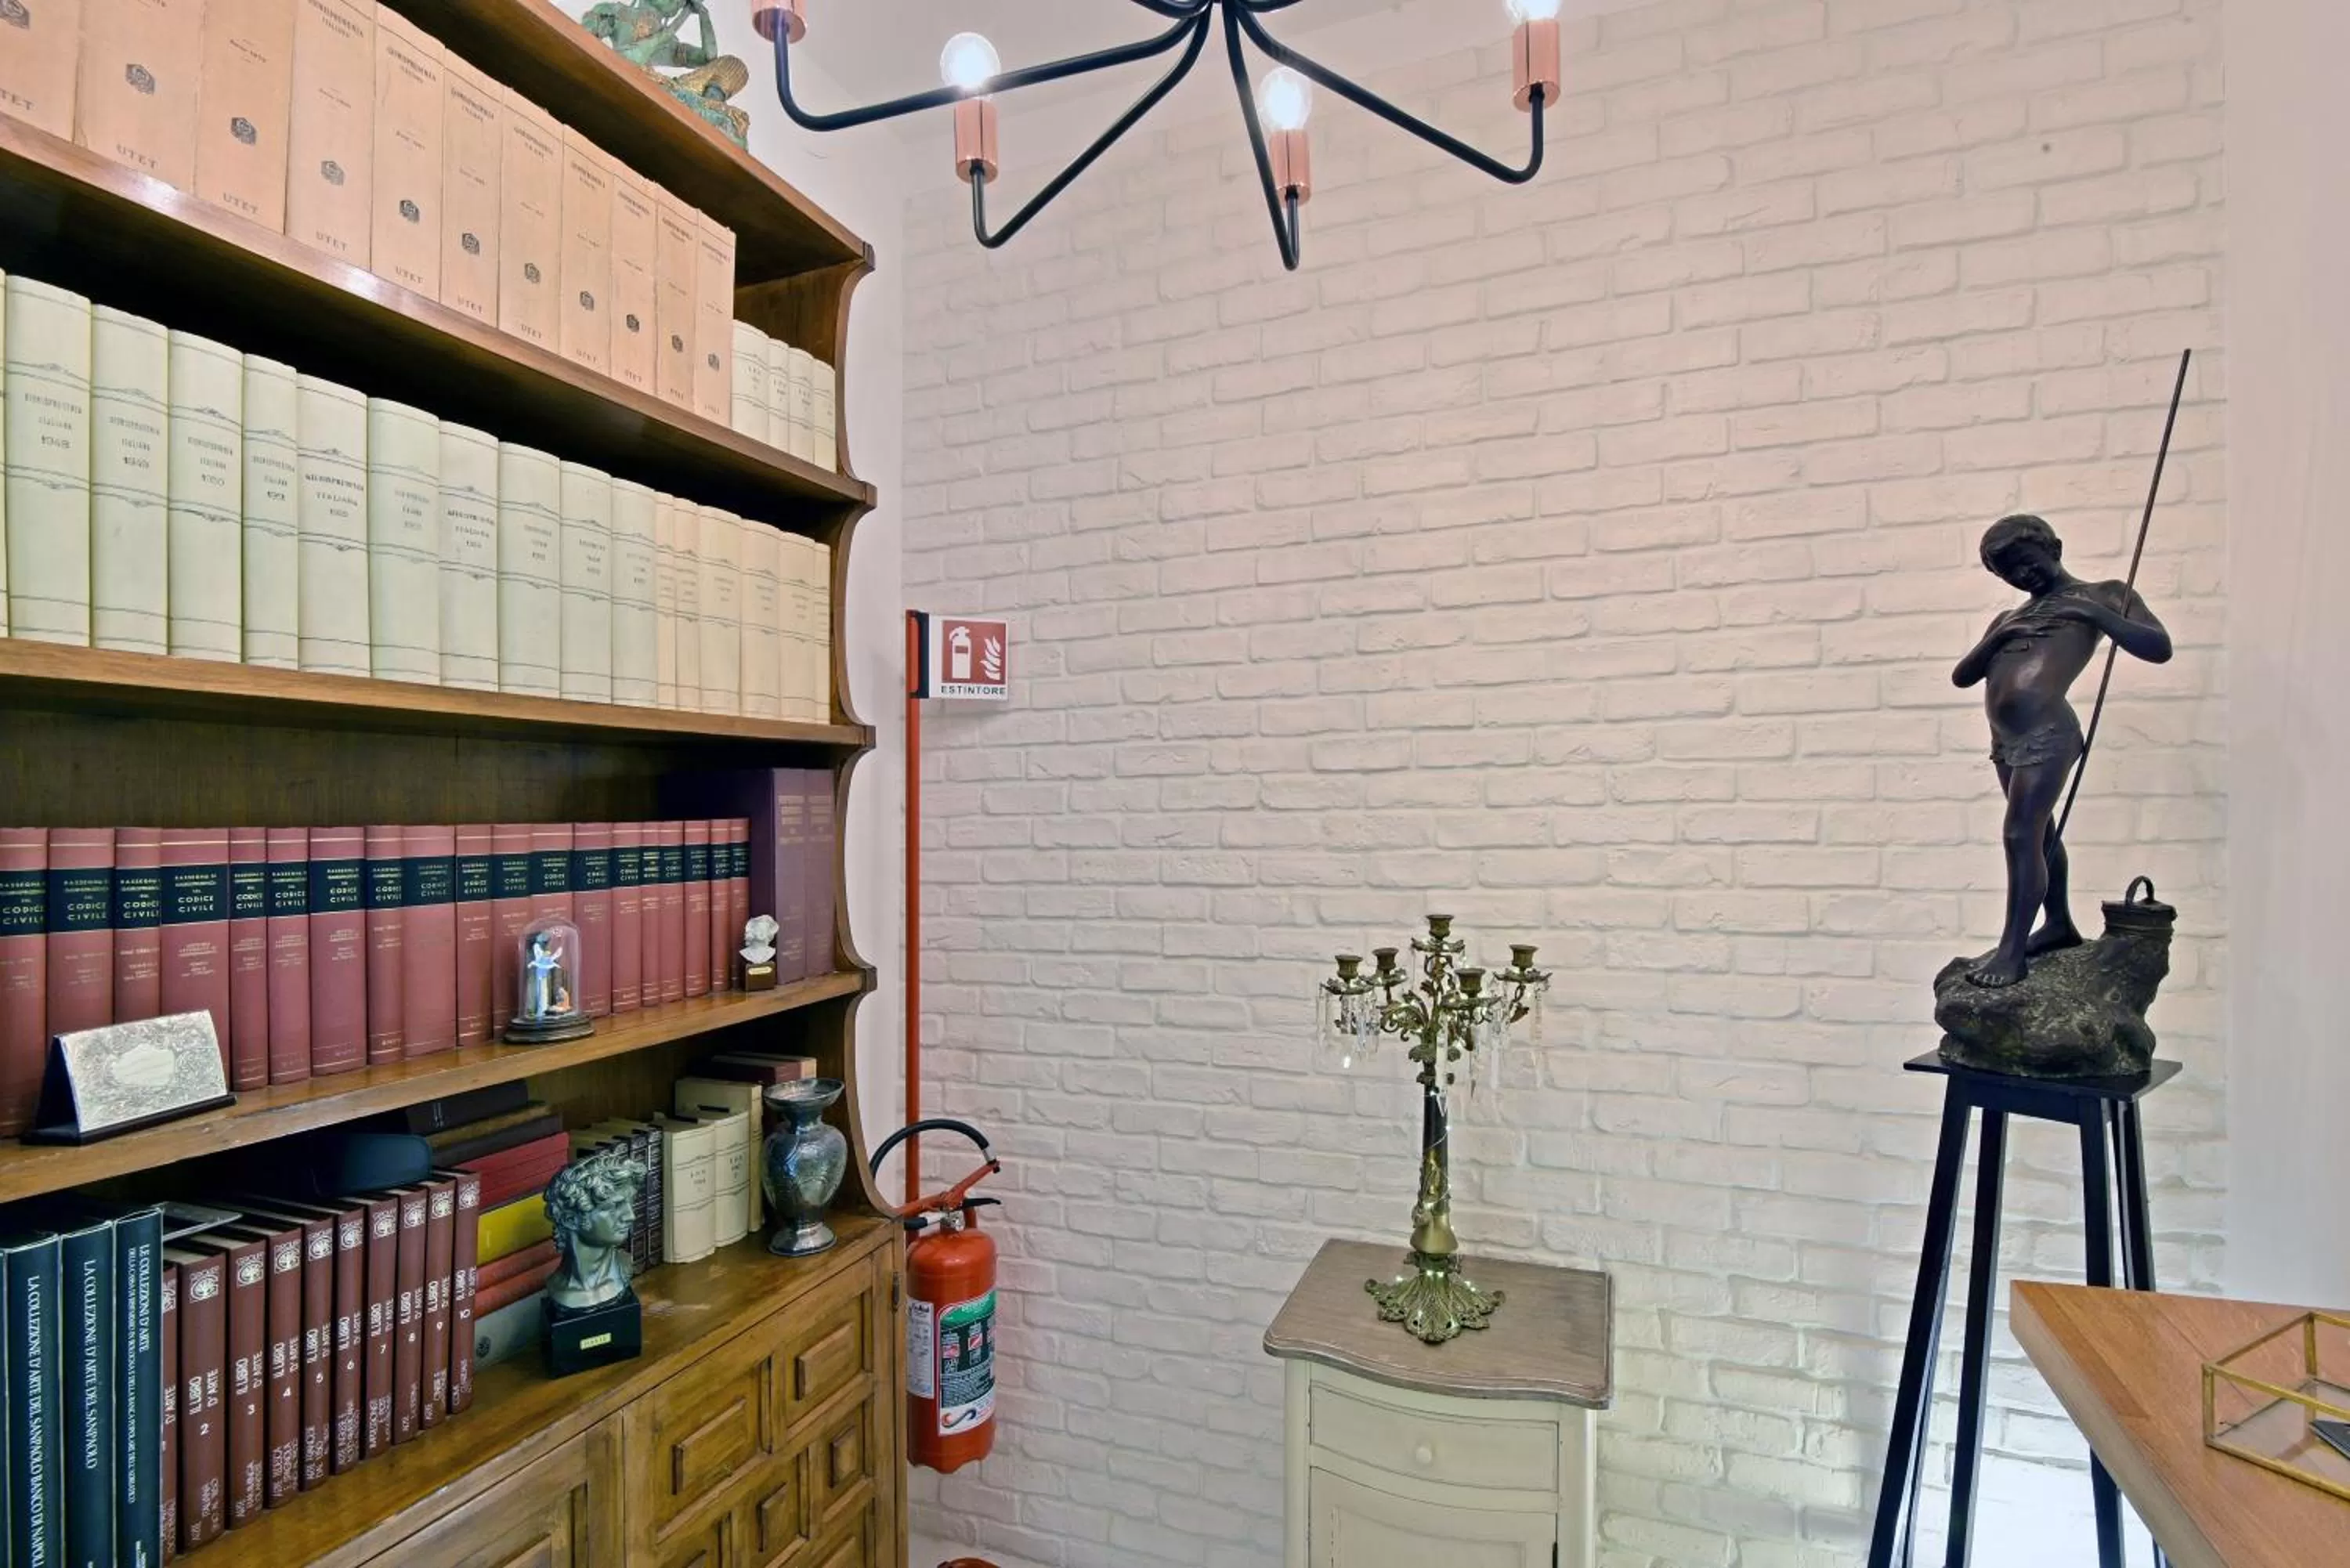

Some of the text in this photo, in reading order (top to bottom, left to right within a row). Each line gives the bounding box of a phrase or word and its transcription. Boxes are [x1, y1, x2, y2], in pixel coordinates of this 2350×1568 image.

[0, 88, 33, 110] TET
[116, 143, 157, 169] UTET
[223, 192, 259, 215] UTET
[316, 231, 349, 251] UTET
[941, 685, 1005, 695] ESTINTORE
[67, 902, 107, 911] CODICE
[178, 904, 214, 913] CIVILE
[139, 1244, 150, 1257] LE
[84, 1259, 97, 1276] LA
[27, 1275, 40, 1292] LA
[139, 1257, 150, 1317] COLLEZIONI
[428, 1281, 439, 1305] LIBRO
[84, 1276, 97, 1346] COLLEZIONE
[371, 1302, 381, 1328] LIBRO
[401, 1292, 411, 1316] LIBRO
[459, 1309, 470, 1320] 10
[28, 1292, 41, 1357] COLLEZIONE
[338, 1317, 349, 1341] LIBRO
[436, 1321, 443, 1331] 9
[306, 1328, 319, 1353] LIBRO
[408, 1332, 416, 1342] 8
[273, 1342, 285, 1368] LIBRO
[380, 1344, 386, 1354] 7
[237, 1358, 248, 1386] LIBRO
[347, 1360, 354, 1370] 6
[85, 1386, 98, 1410] DEL
[189, 1376, 202, 1404] LIBRO
[283, 1386, 291, 1397] 4
[29, 1396, 42, 1418] DEL
[248, 1404, 255, 1415] 3
[85, 1409, 98, 1469] SANPAOLO
[201, 1423, 209, 1436] 2
[29, 1417, 42, 1475] SANPAOLO
[31, 1474, 43, 1514] BANCO
[31, 1512, 43, 1528] DI
